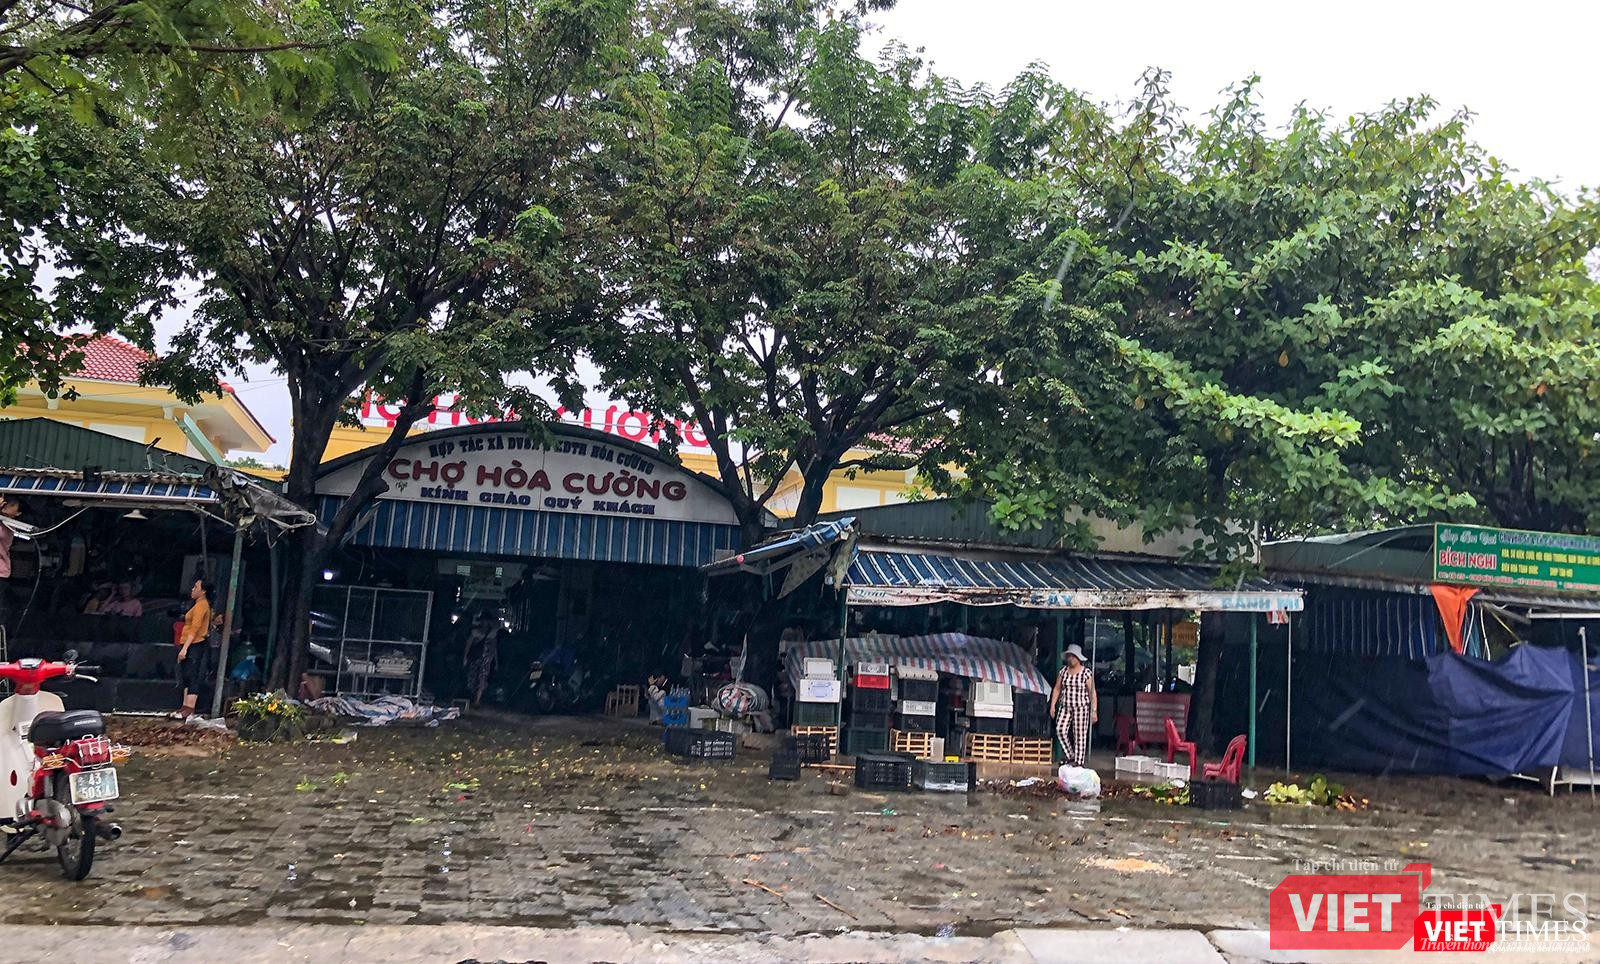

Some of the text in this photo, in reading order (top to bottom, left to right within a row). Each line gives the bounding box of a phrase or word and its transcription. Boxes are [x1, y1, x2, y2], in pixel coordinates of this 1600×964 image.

[459, 437, 484, 453] TÁC
[387, 458, 688, 501] CHỢ HÒA CƯỜNG
[420, 485, 656, 516] KÍNH CHÀO QUÝ KHÁCH
[1439, 546, 1467, 568] BÍCH
[1468, 552, 1497, 570] NGHI
